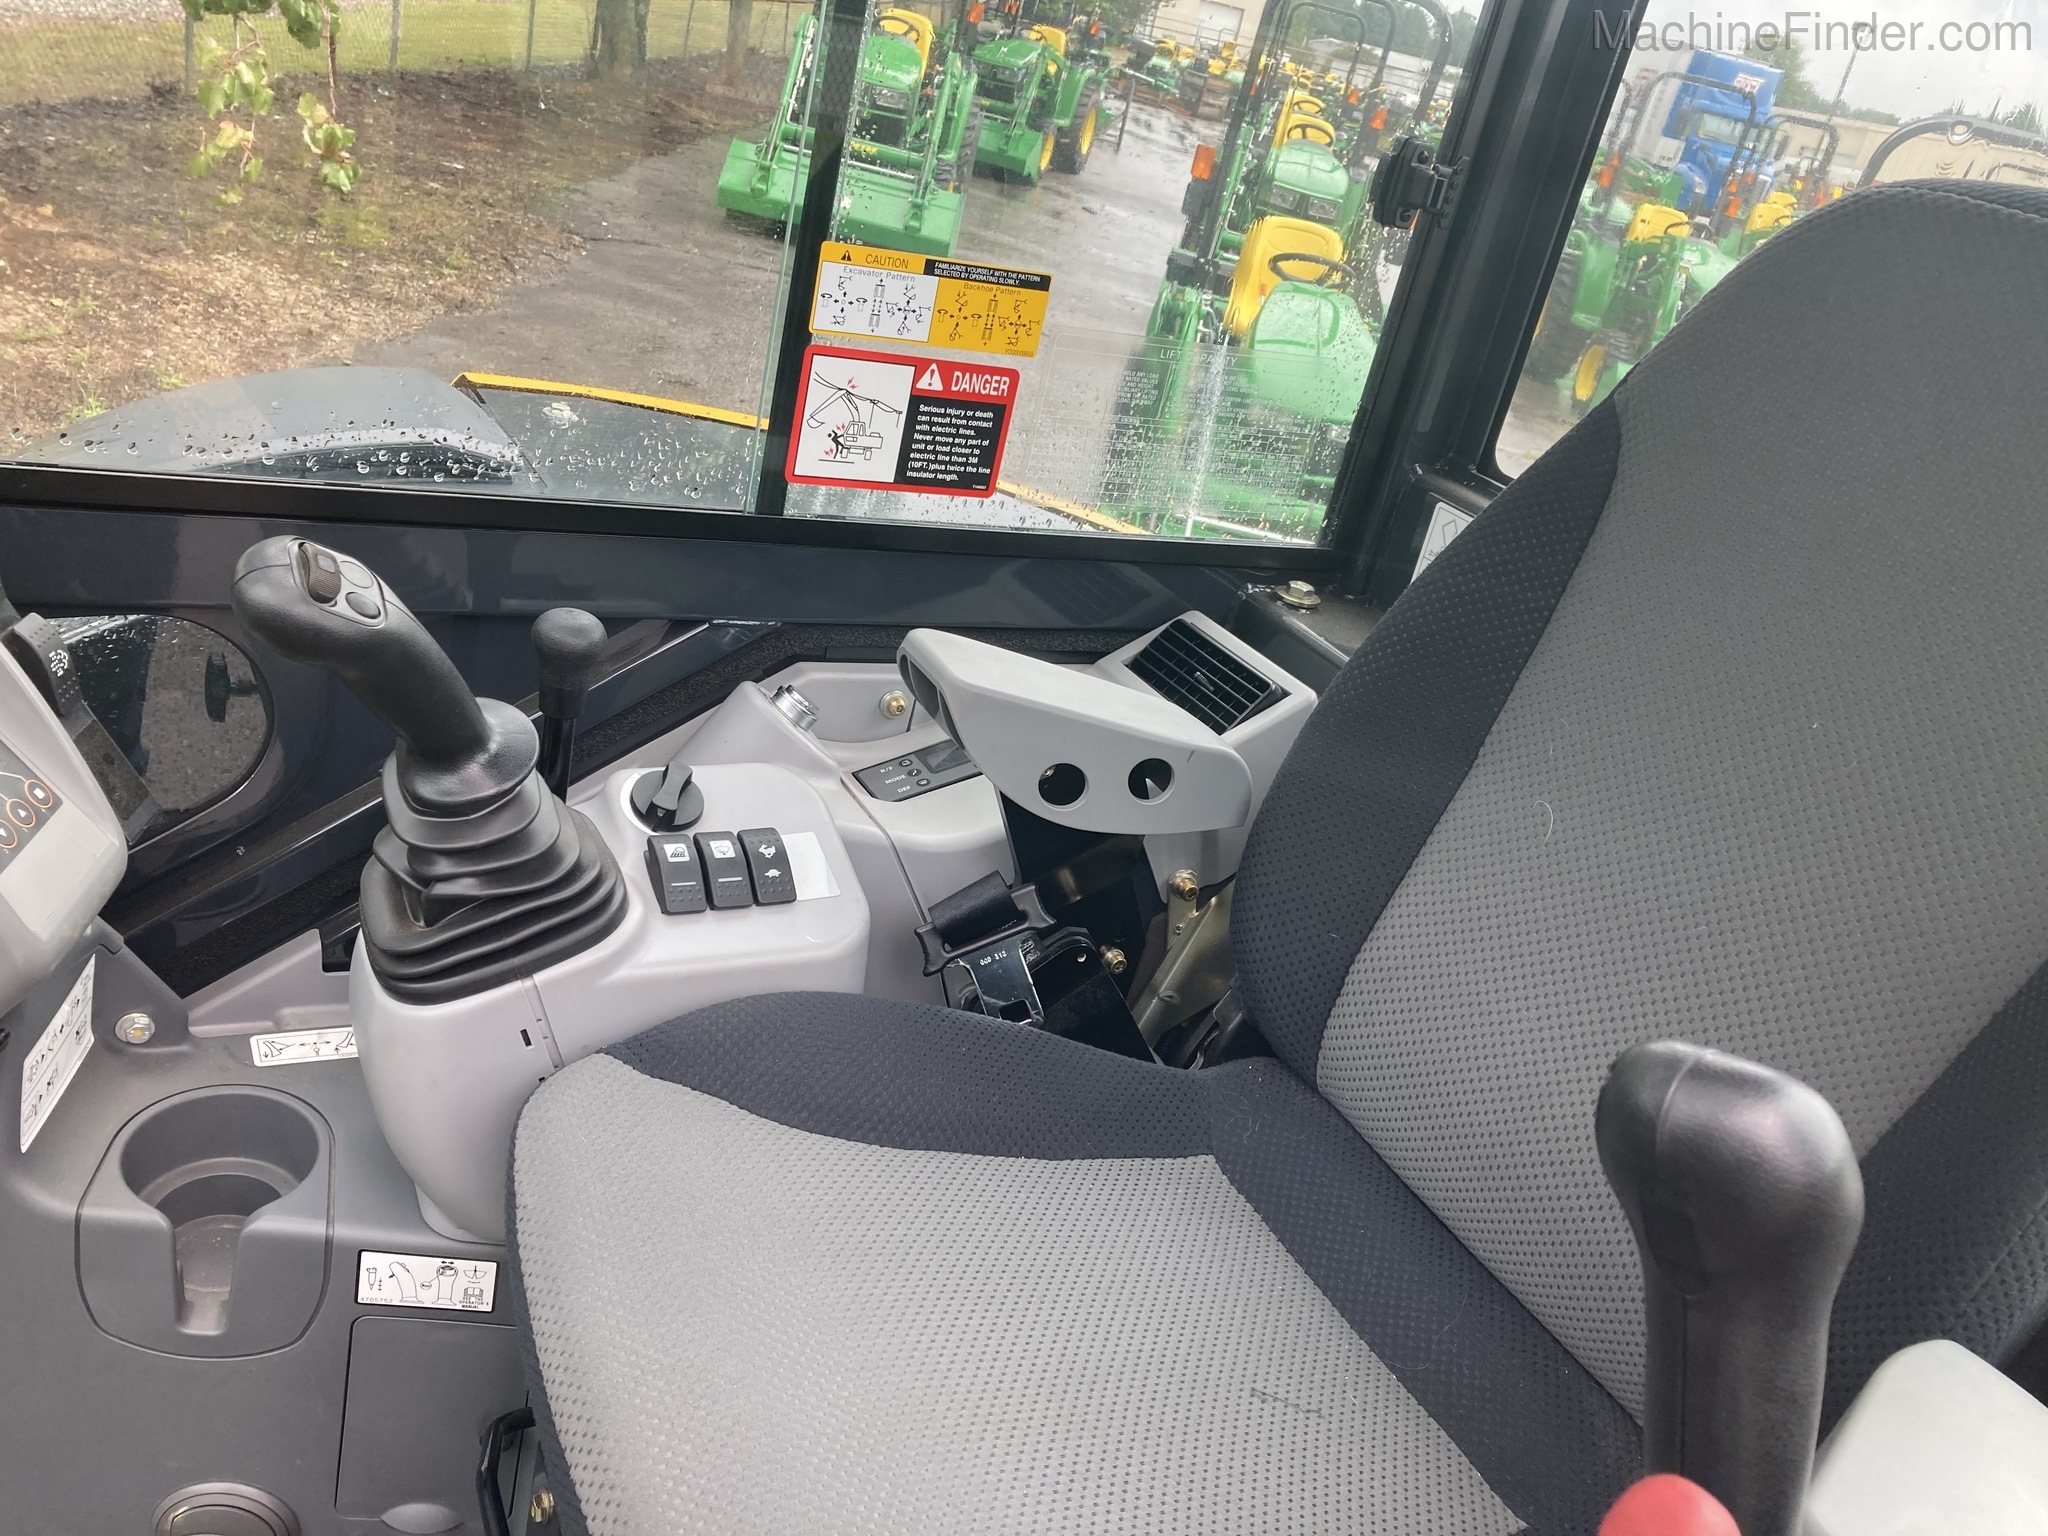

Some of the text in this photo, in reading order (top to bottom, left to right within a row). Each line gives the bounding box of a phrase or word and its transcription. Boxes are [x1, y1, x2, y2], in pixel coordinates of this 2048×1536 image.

[866, 254, 909, 269] CAUTION
[844, 266, 916, 282] Excavator Pattern
[934, 262, 966, 270] FAMILIARIZE
[967, 266, 993, 276] YOURSELF
[1018, 273, 1040, 282] PATTERN
[934, 269, 960, 278] SELECTED
[969, 273, 998, 283] OPERATING
[998, 277, 1020, 286] SLOWLY.
[964, 282, 1022, 296] Backhoe Pattern
[1160, 349, 1182, 360] LIFT
[951, 371, 1010, 397] DANGER
[919, 404, 945, 413] Serious
[946, 407, 965, 417] injury
[932, 426, 956, 434] electric
[910, 452, 935, 460] electric
[907, 470, 959, 482] insulator length.
[885, 774, 906, 784] MODE
[897, 785, 911, 793] DEF
